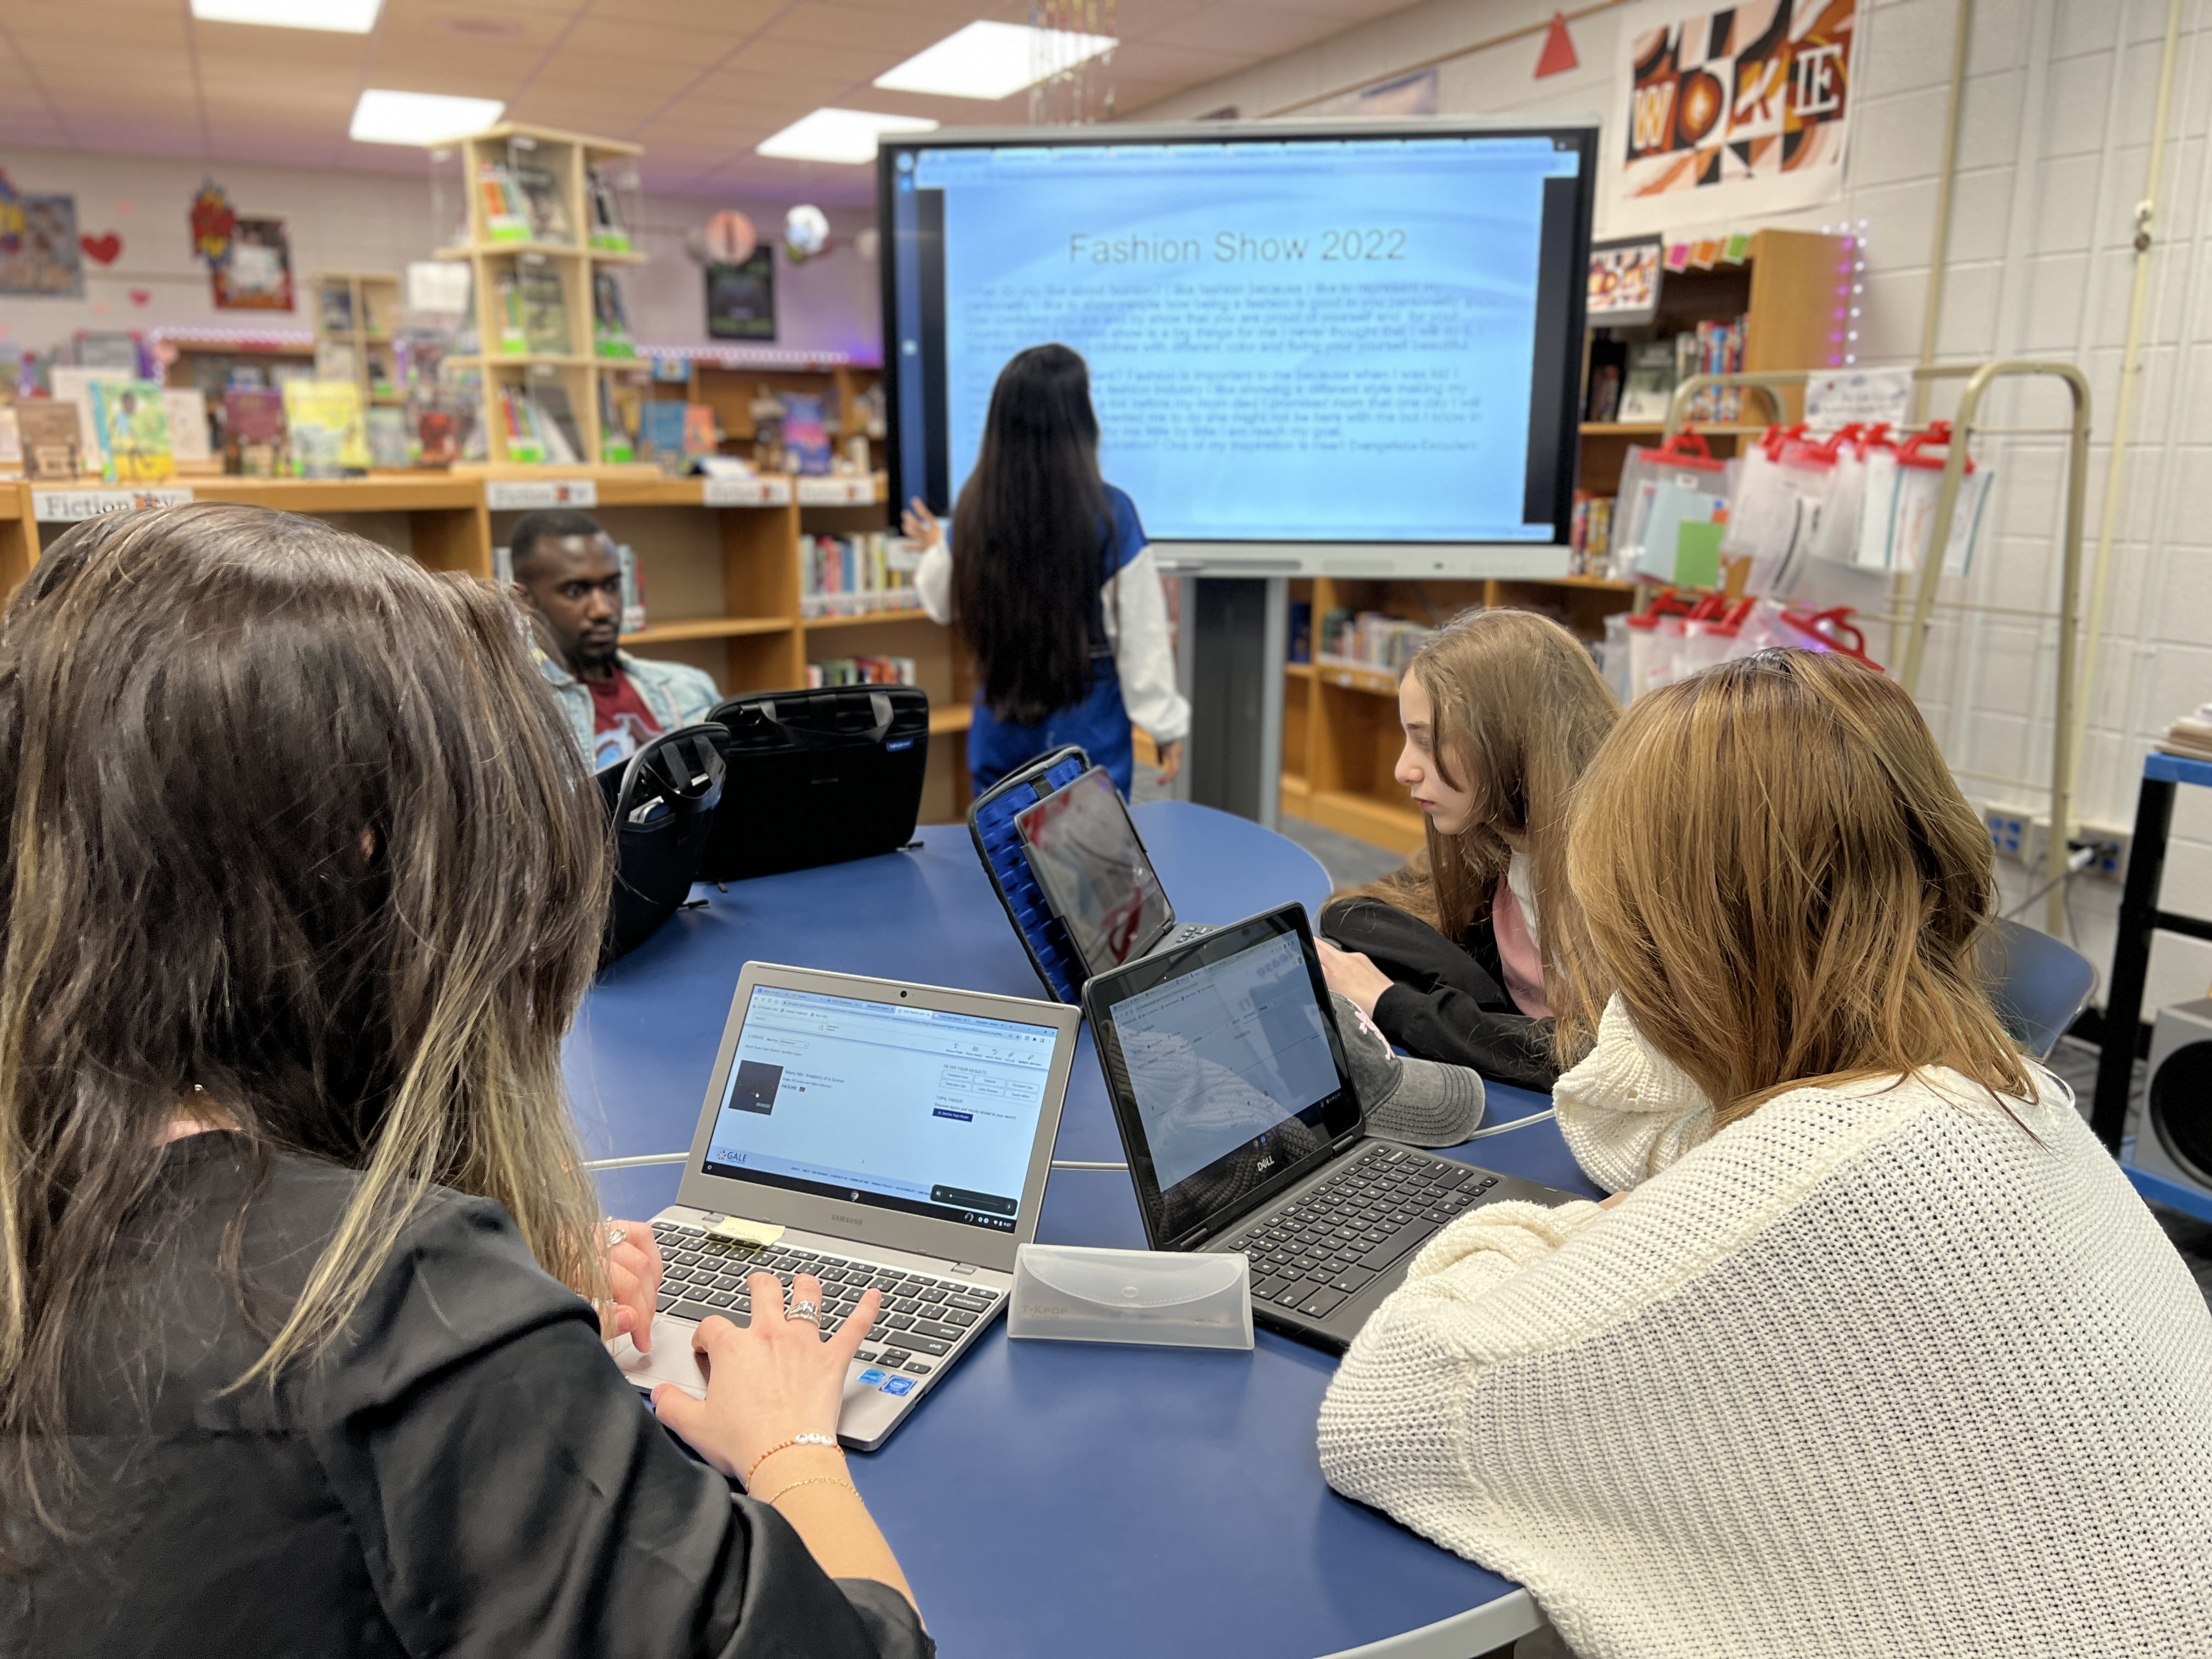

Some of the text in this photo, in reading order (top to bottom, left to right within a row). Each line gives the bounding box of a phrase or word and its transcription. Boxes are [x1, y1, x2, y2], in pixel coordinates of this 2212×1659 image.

[1632, 43, 1843, 149] WOKE
[1069, 228, 1408, 263] Fashion Show 2022
[727, 1152, 747, 1162] GALE
[1257, 1157, 1275, 1172] DELL
[831, 1214, 862, 1226] SAMSUNG
[953, 1297, 982, 1307] backspace
